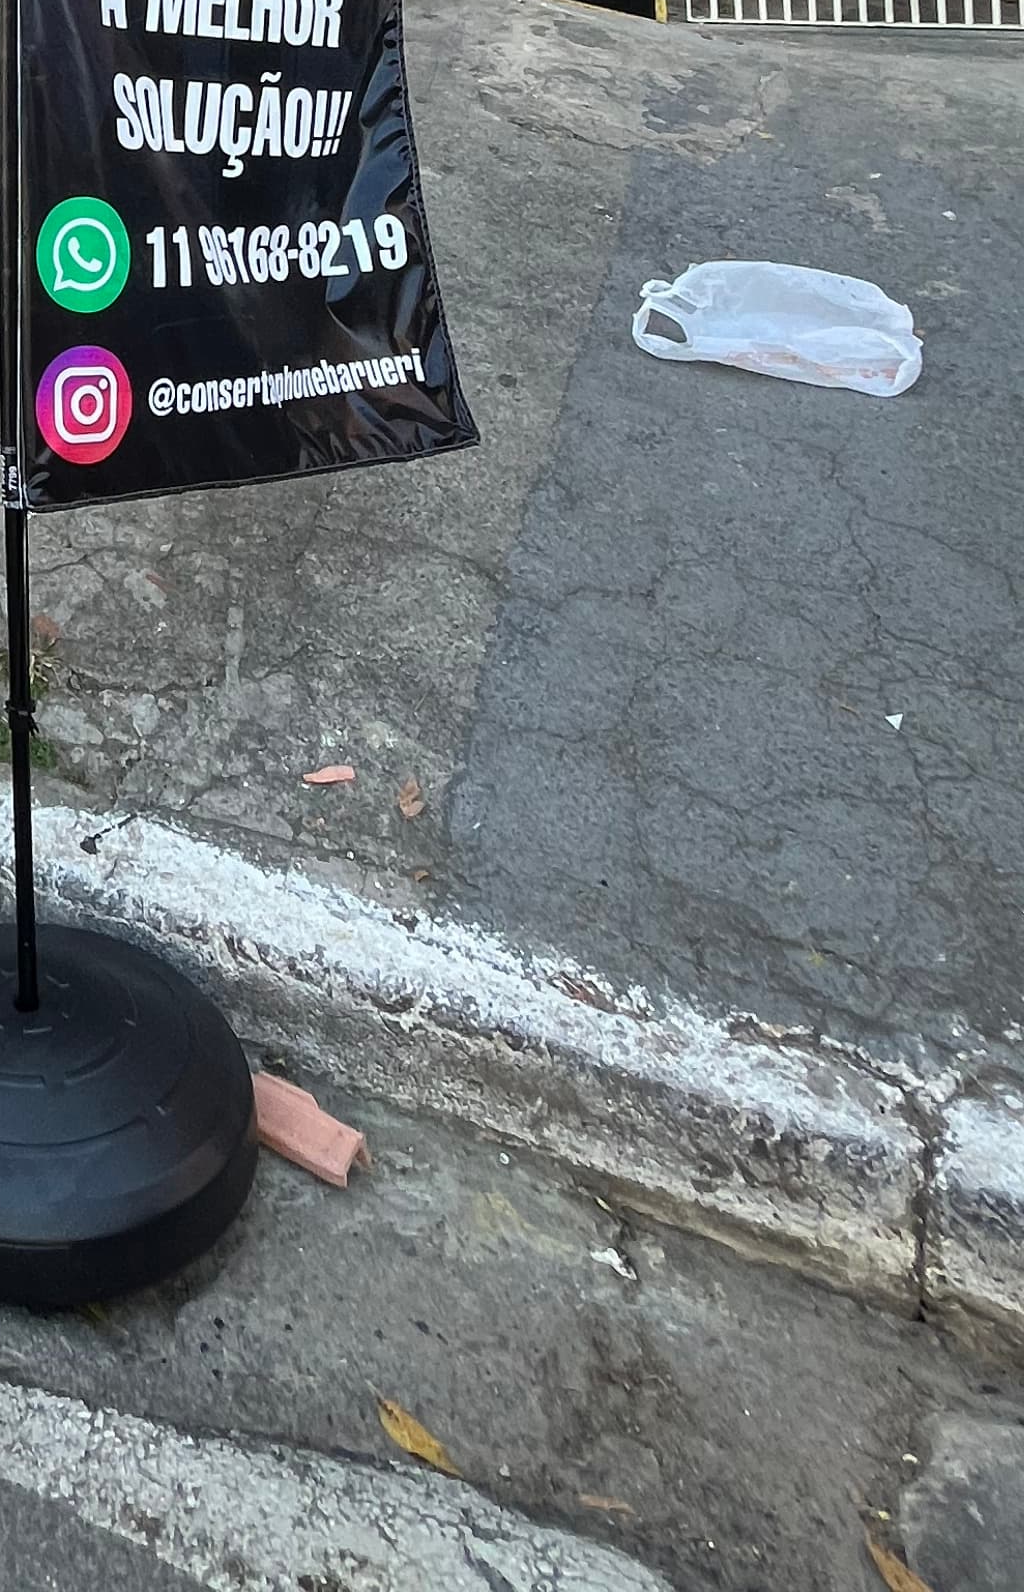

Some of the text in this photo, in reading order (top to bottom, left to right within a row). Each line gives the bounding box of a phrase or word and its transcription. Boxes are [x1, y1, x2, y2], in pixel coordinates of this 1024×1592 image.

[113, 72, 353, 178] SOLUÇÃO!!!
[146, 214, 408, 288] 11 96168-8219
[148, 348, 425, 417] @consertaphonebarueri
